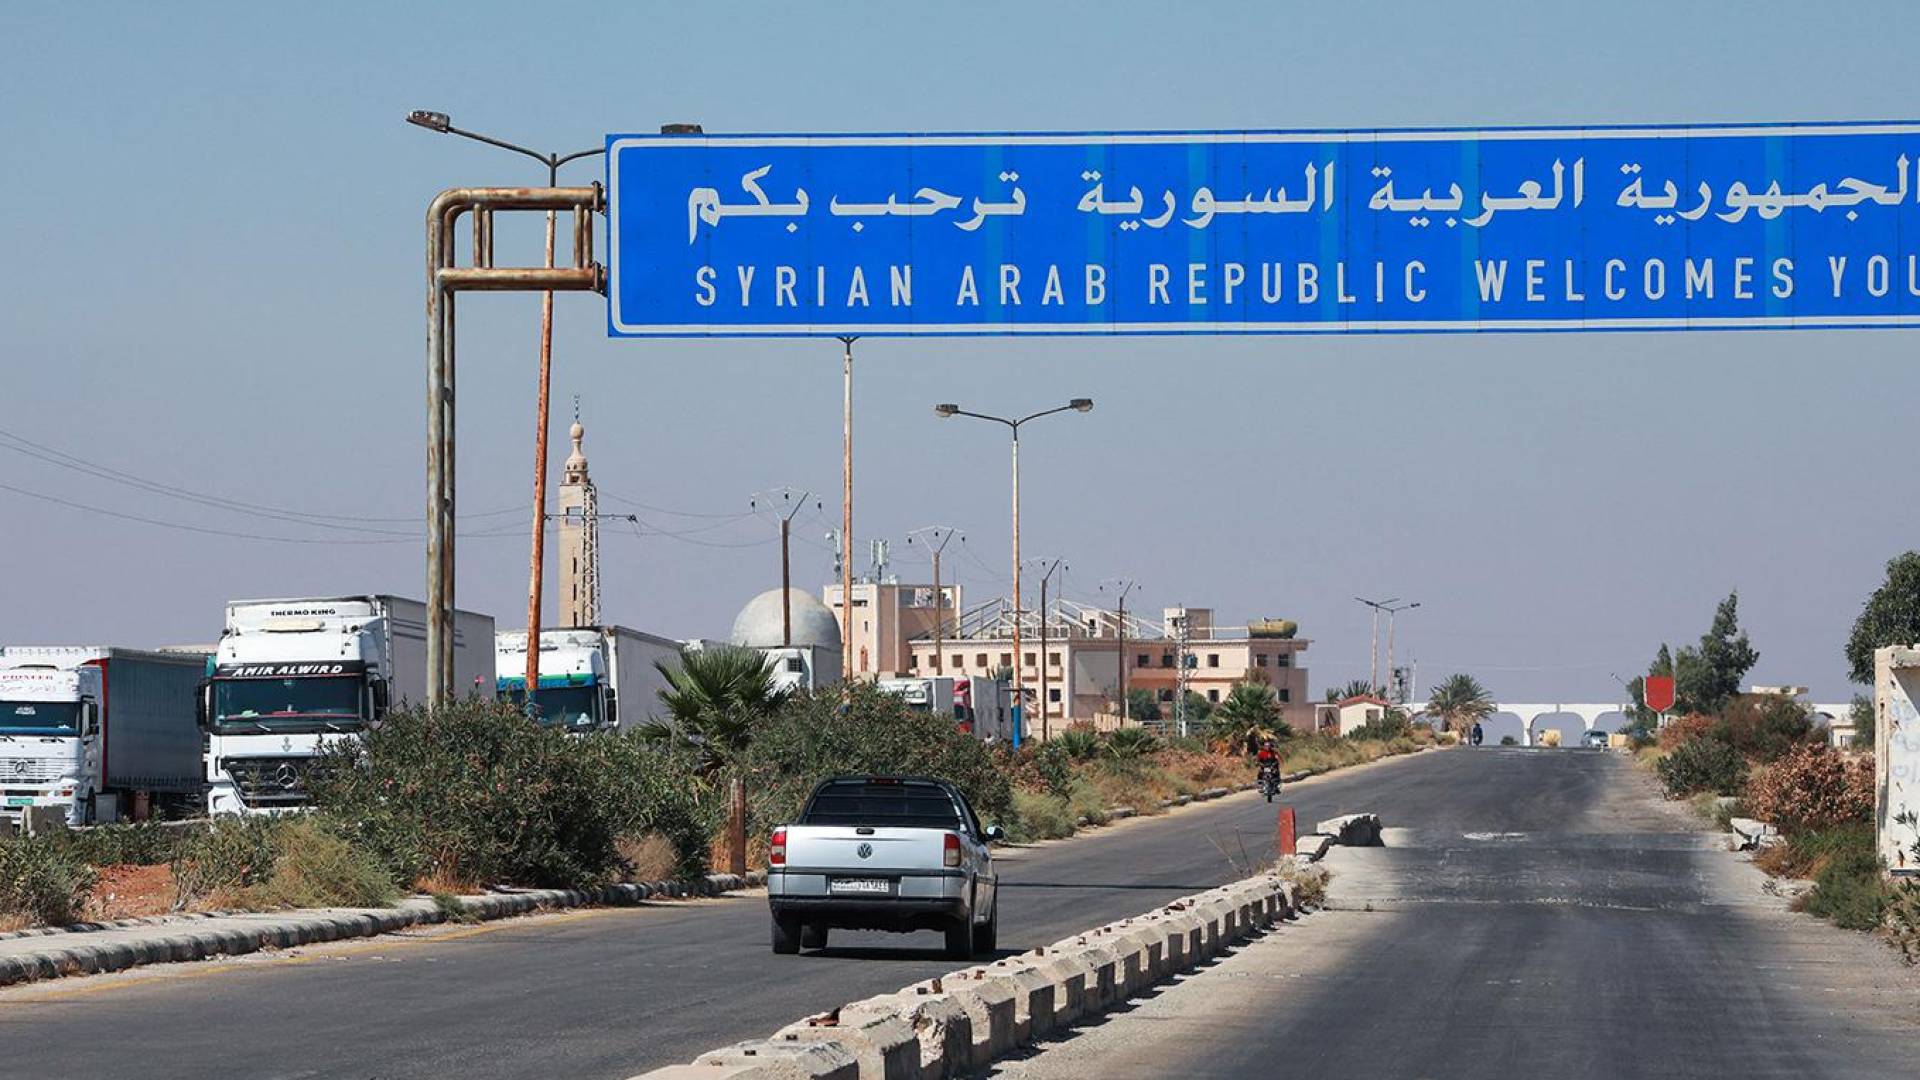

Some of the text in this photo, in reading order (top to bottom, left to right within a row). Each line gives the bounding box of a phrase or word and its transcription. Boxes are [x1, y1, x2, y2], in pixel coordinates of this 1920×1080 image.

[689, 152, 1920, 245] لجمهورية العربية السورية ترحب بكم
[696, 265, 912, 307] SYRIAN
[957, 264, 1106, 305] ARAB
[1149, 261, 1427, 304] REPUBLIC
[1475, 258, 1794, 302] WELCOMES
[271, 608, 336, 617] THERMO KING
[232, 664, 343, 677] AMIR ALWIRD
